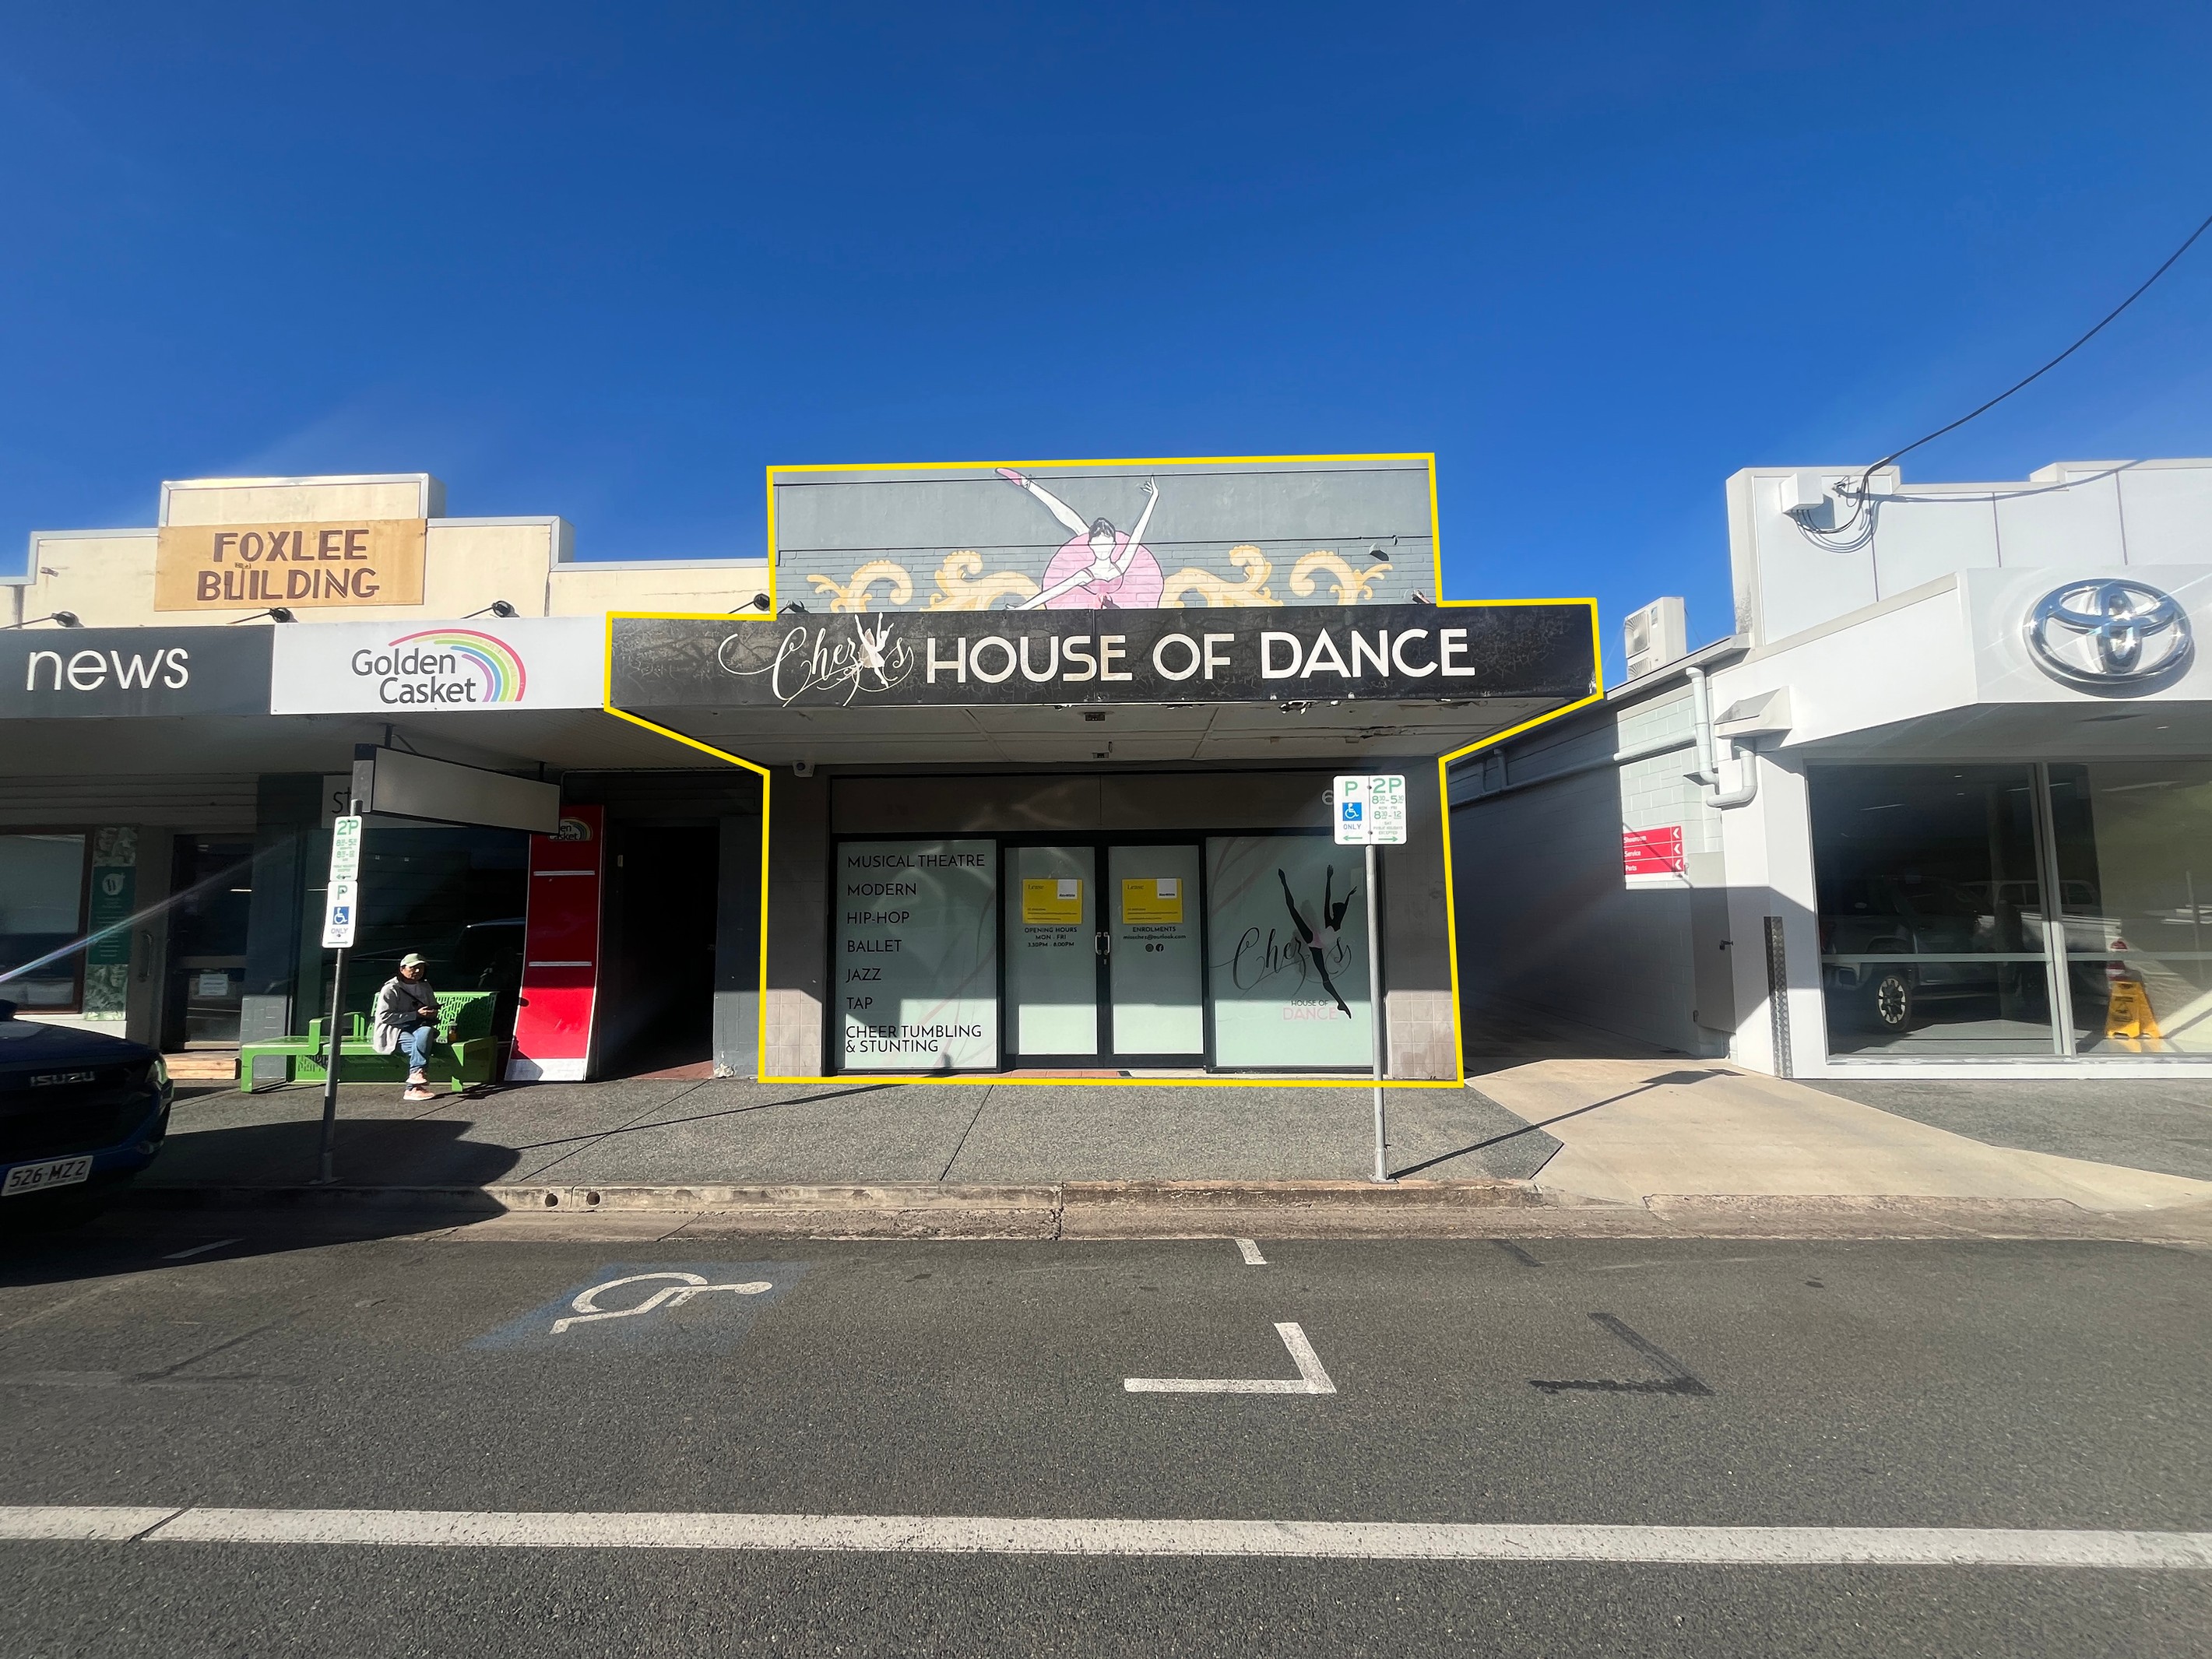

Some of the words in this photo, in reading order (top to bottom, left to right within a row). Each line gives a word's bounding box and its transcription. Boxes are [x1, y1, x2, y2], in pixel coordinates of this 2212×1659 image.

[213, 529, 370, 563] FOXLEE
[197, 568, 380, 602] BUILDING
[351, 647, 456, 677] Golden
[926, 634, 1133, 684] HOUSE
[1152, 633, 1235, 680] OF
[1261, 627, 1475, 679] DANCE
[26, 648, 190, 692] news
[378, 677, 477, 705] Casket
[1345, 781, 1358, 796] P
[1373, 778, 1401, 793] 2P
[336, 820, 359, 835] 2P
[848, 855, 915, 868] MUSICAL
[918, 854, 985, 867] THEATRE
[337, 884, 348, 901] P
[847, 883, 916, 896] MODERN
[846, 911, 909, 924] HIP-HOP
[847, 940, 902, 953] BALLET
[846, 968, 881, 982] JAZZ
[846, 996, 873, 1010] TAP
[1282, 1007, 1338, 1020] DANCE
[846, 1025, 899, 1039] CHEER
[901, 1025, 982, 1038] TUMBLING
[846, 1040, 856, 1053] &
[860, 1039, 938, 1053] STUNTING
[30, 1070, 96, 1088] ISUZU
